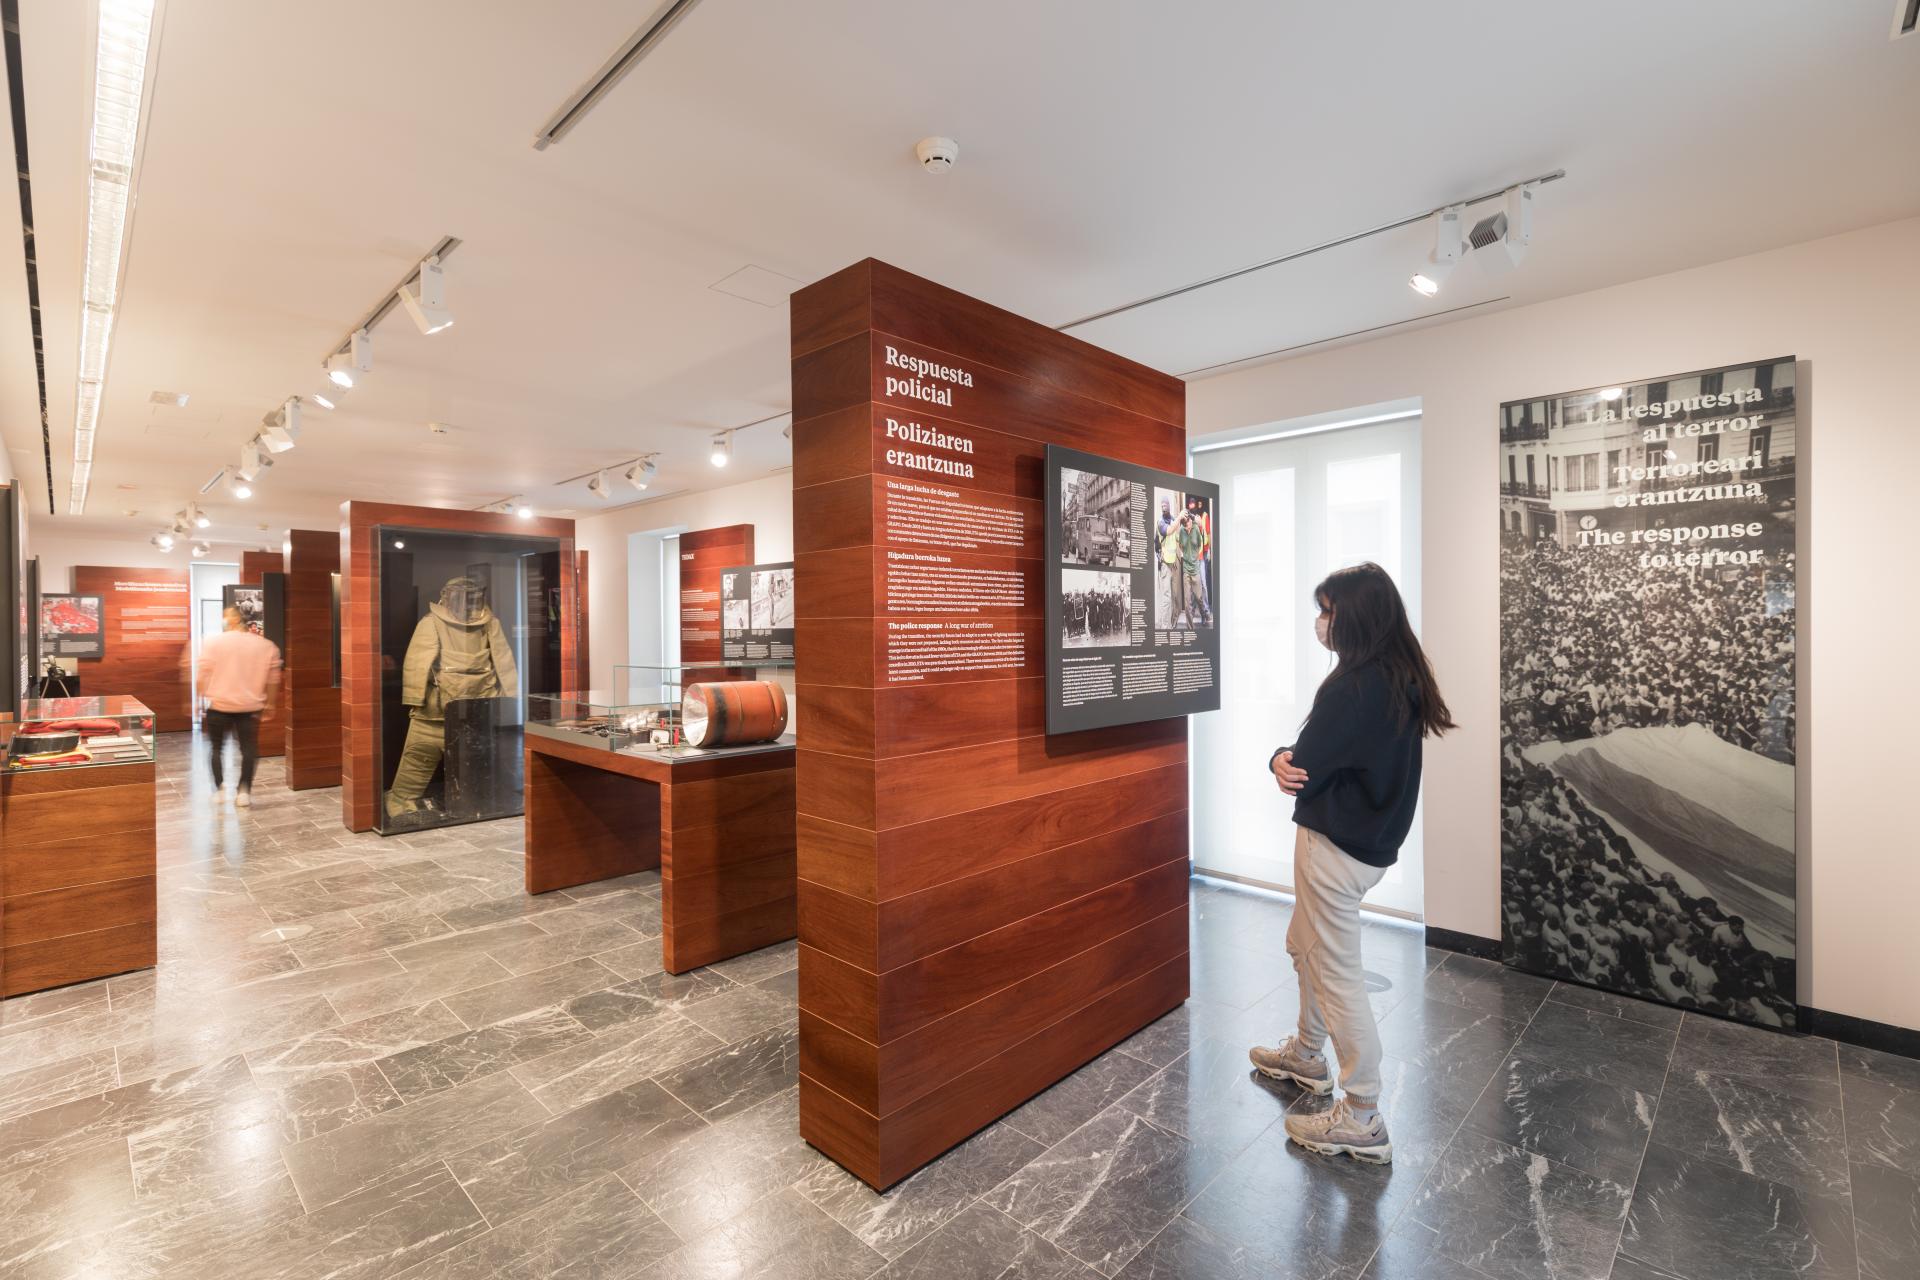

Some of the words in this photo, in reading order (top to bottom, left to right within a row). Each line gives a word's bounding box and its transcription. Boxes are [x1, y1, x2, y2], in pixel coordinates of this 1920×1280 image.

[885, 345, 973, 388] Respuesta
[885, 376, 952, 407] policial
[1584, 409, 1617, 425] La
[1621, 387, 1764, 420] respuesta
[885, 417, 974, 454] Poliziaren
[1642, 423, 1668, 443] al
[1674, 414, 1764, 439] terror
[886, 449, 974, 479] erantzuna
[1613, 450, 1764, 484] Terroreari
[887, 481, 899, 489] Una
[899, 482, 914, 492] larga
[914, 485, 929, 493] lucha
[937, 488, 959, 498] desgaste
[1613, 482, 1764, 508] erantzuna
[1575, 529, 1626, 547] The
[1631, 522, 1763, 546] response
[1639, 552, 1668, 569] to
[1674, 548, 1764, 567] terror
[900, 622, 917, 630] police
[949, 622, 960, 630] long
